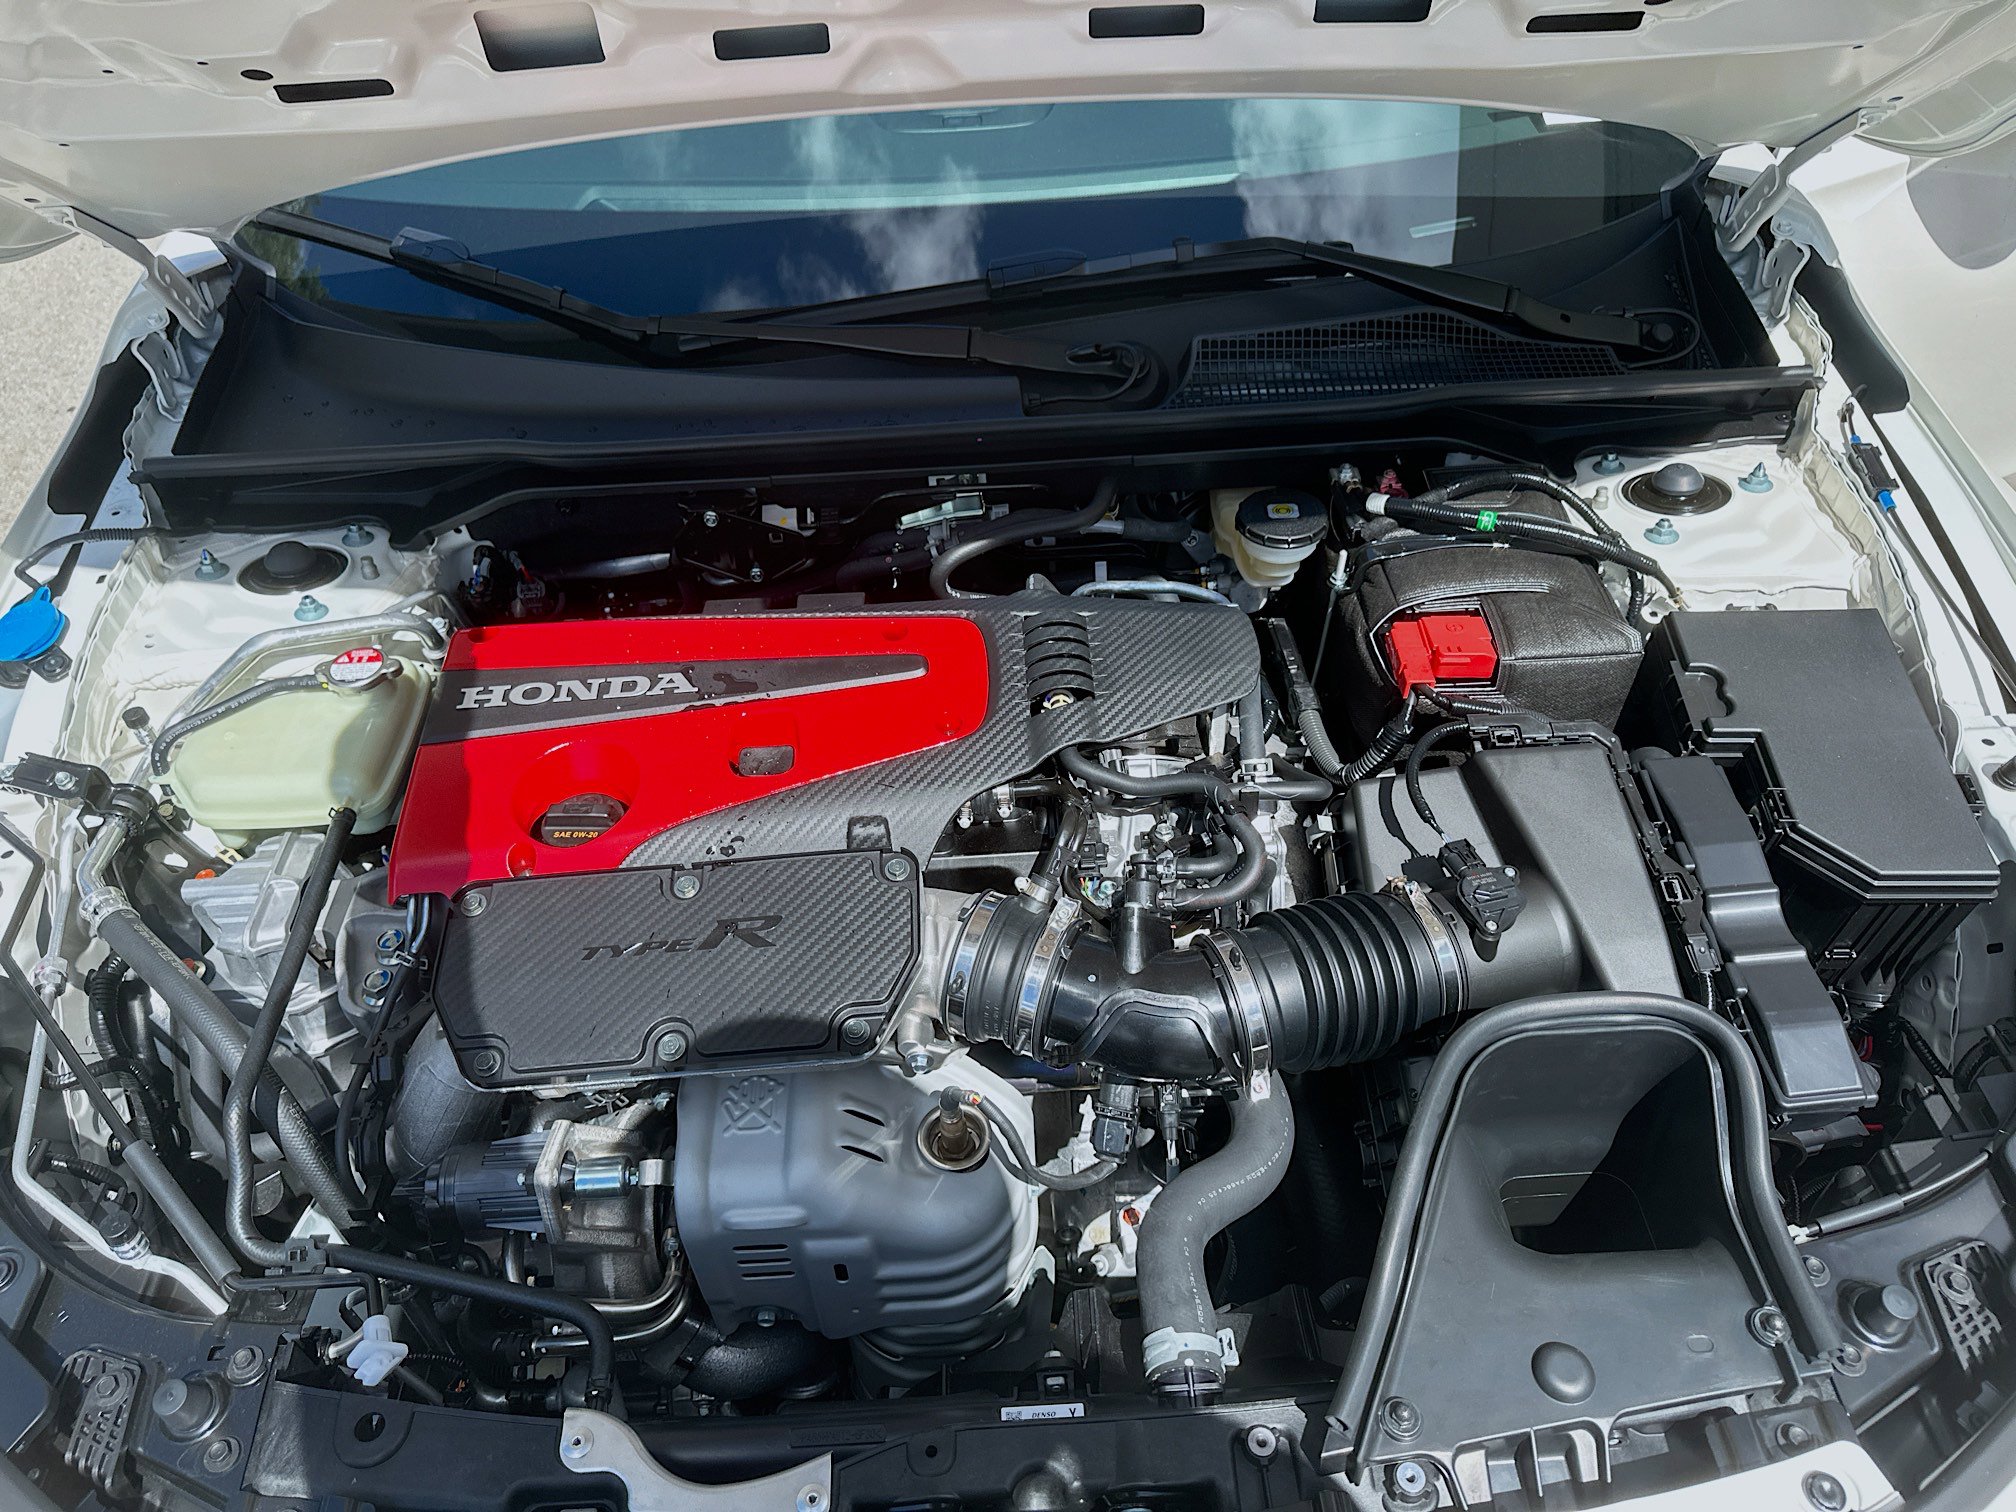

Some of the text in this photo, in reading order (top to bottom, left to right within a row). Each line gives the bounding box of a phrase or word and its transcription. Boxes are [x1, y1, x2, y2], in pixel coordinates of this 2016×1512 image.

[456, 672, 699, 709] HONDA
[581, 914, 784, 961] TYPE R
[1031, 1408, 1077, 1419] DENSO Y
